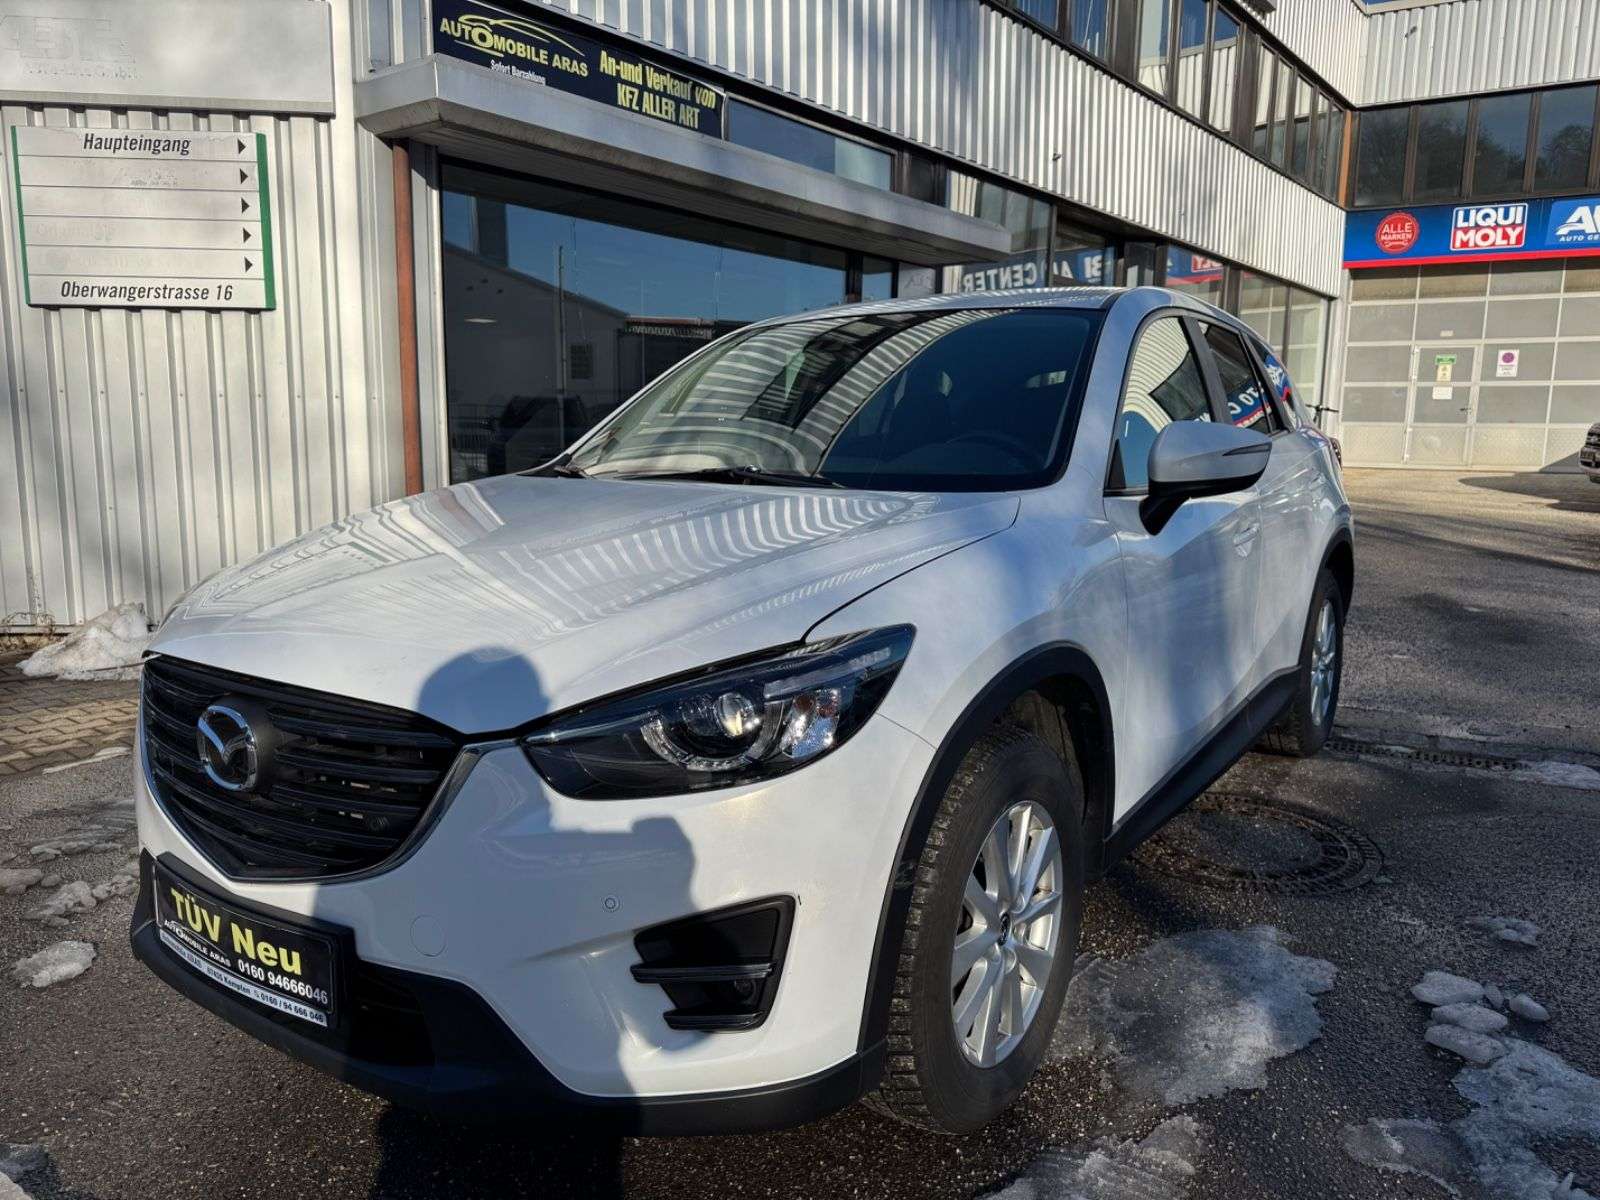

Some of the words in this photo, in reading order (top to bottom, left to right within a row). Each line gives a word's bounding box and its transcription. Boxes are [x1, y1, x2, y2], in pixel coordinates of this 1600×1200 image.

[440, 17, 549, 65] AUTOMOBILE
[552, 53, 588, 77] ARAS
[646, 65, 692, 101] Verkauf
[695, 85, 716, 109] von
[617, 82, 640, 111] KFZ
[642, 90, 676, 122] ALLER
[679, 102, 700, 129] ART
[83, 132, 192, 156] Haupteingang
[1382, 221, 1412, 234] ALLE
[1456, 205, 1523, 228] LIQUI
[1380, 232, 1413, 242] MARKEN
[1454, 226, 1523, 248] MOLY
[1559, 234, 1584, 242] AUTO
[61, 280, 209, 302] Oberwangerstrasse
[216, 284, 233, 301] 16
[170, 886, 220, 943] TÜV
[230, 921, 302, 976] Neu
[238, 959, 265, 982] 0160
[267, 970, 328, 1005] 94666046
